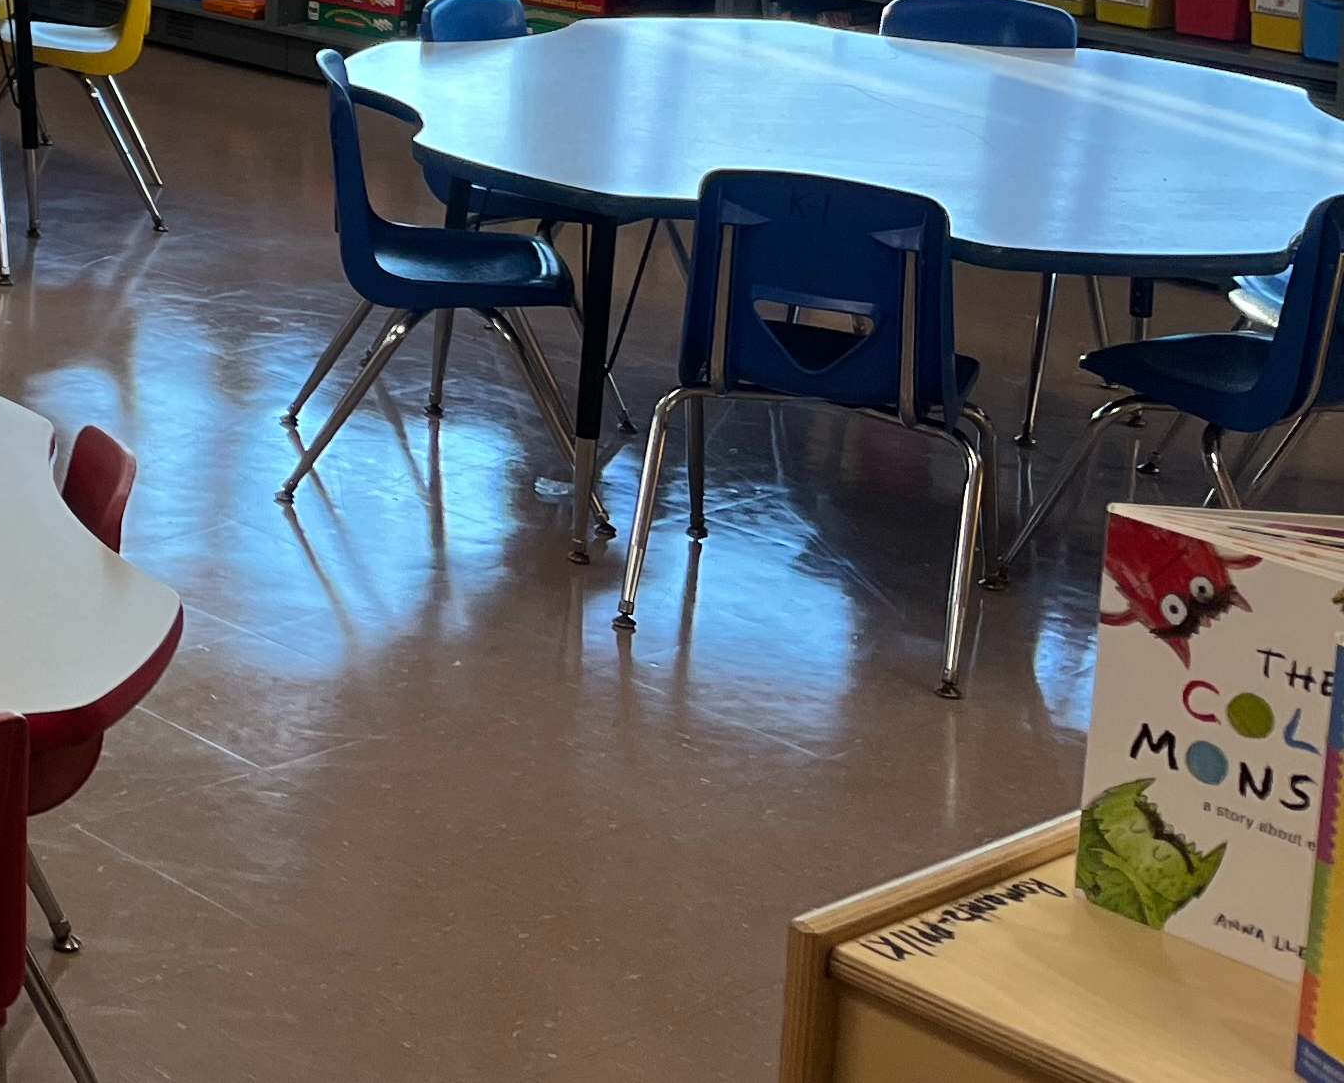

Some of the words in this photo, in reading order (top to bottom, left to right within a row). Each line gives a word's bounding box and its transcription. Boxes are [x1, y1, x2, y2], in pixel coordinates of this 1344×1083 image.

[1256, 647, 1334, 697] THE
[1203, 800, 1211, 812] a
[1216, 805, 1254, 829] story
[1259, 821, 1302, 846] about
